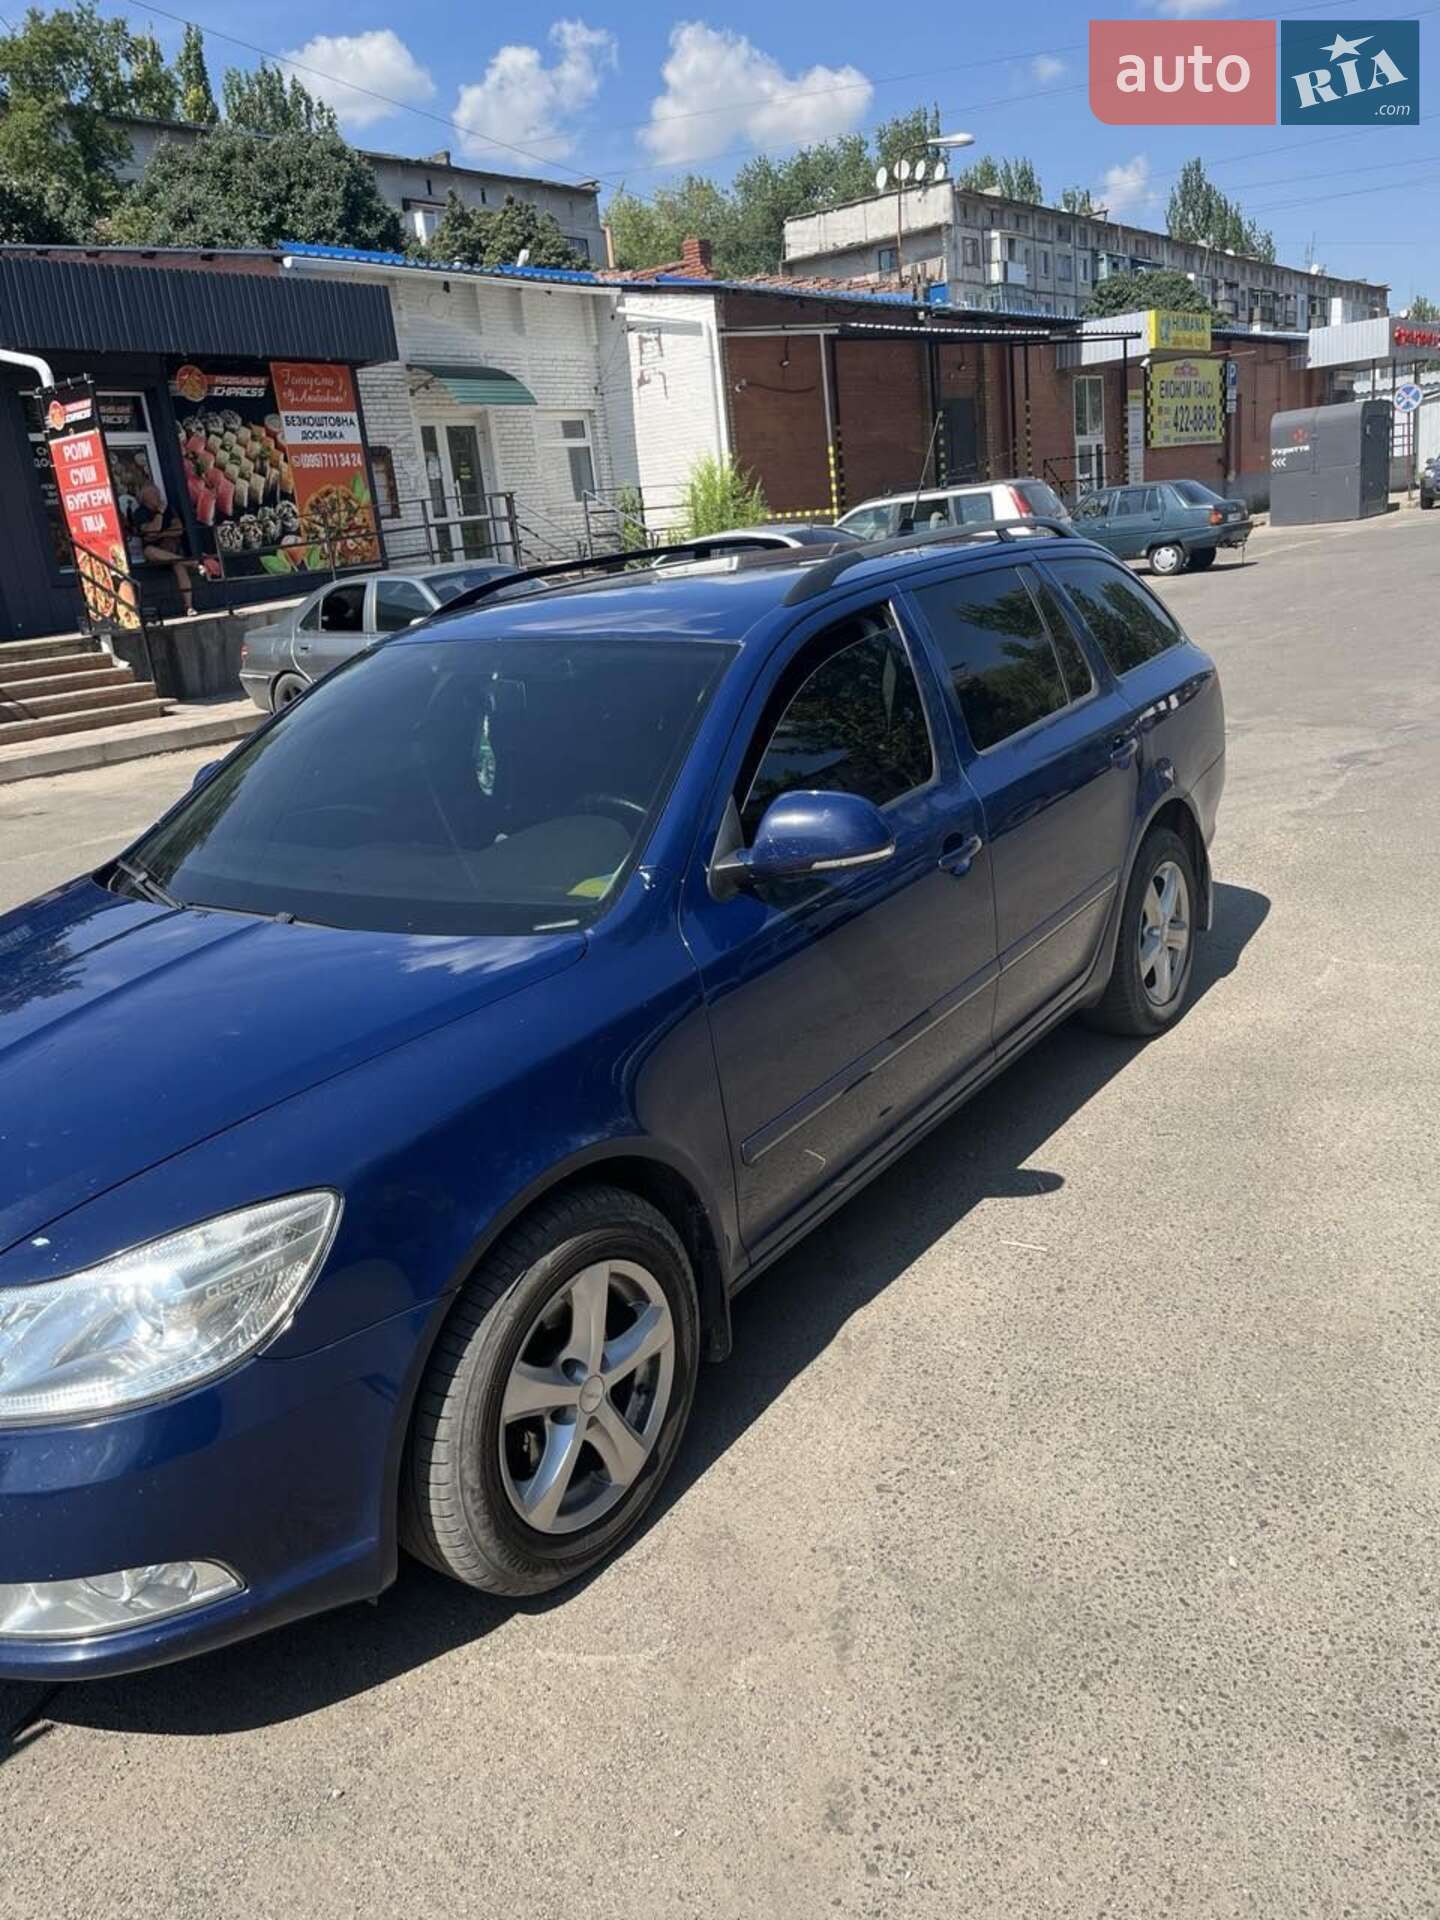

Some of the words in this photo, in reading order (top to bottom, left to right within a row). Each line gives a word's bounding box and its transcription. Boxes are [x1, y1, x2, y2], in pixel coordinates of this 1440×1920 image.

[284, 415, 356, 428] БЕЗКОШТОВНА
[300, 430, 345, 440] ДОСТАВКА
[62, 440, 93, 463] РОЛИ
[66, 488, 113, 512] БУРГЕРИ
